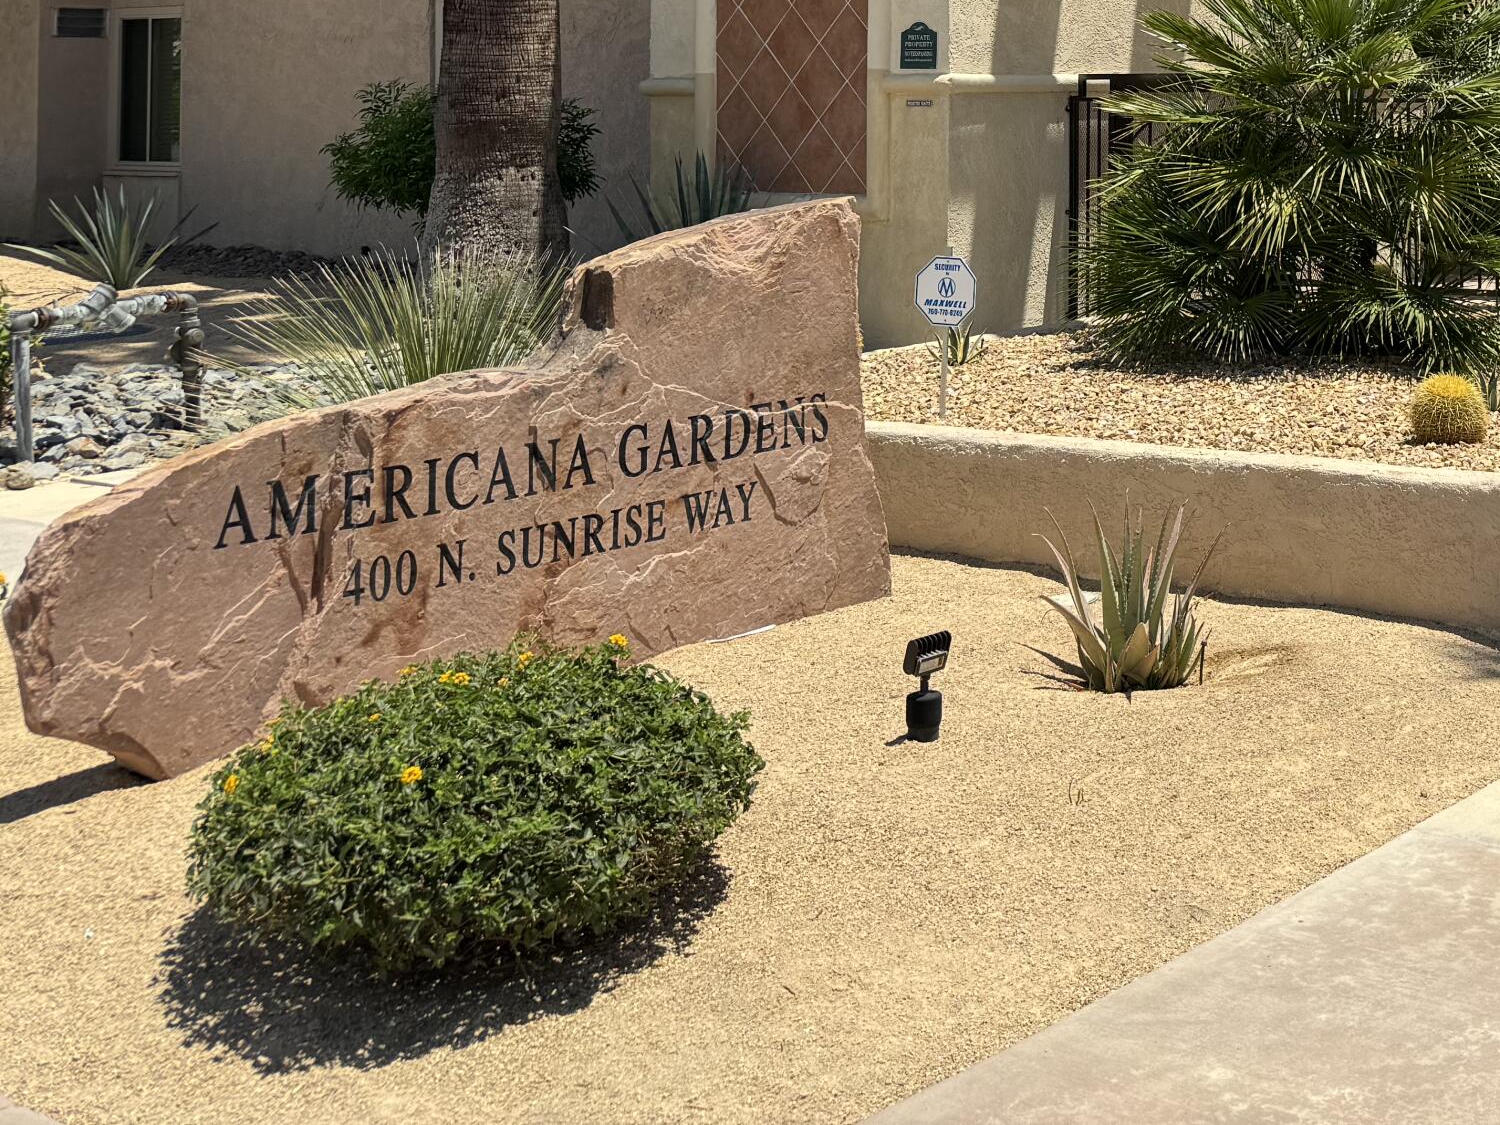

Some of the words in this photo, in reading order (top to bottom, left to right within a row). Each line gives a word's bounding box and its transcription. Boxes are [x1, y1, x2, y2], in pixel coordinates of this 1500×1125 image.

[934, 263, 961, 272] SECURITY
[924, 298, 967, 309] MAXWELL
[213, 432, 596, 550] AMERICANA
[618, 392, 829, 478] GARDENS
[342, 548, 418, 606] 400
[435, 538, 476, 588] N.
[496, 499, 667, 576] SUNRISE
[681, 481, 758, 535] WAY
